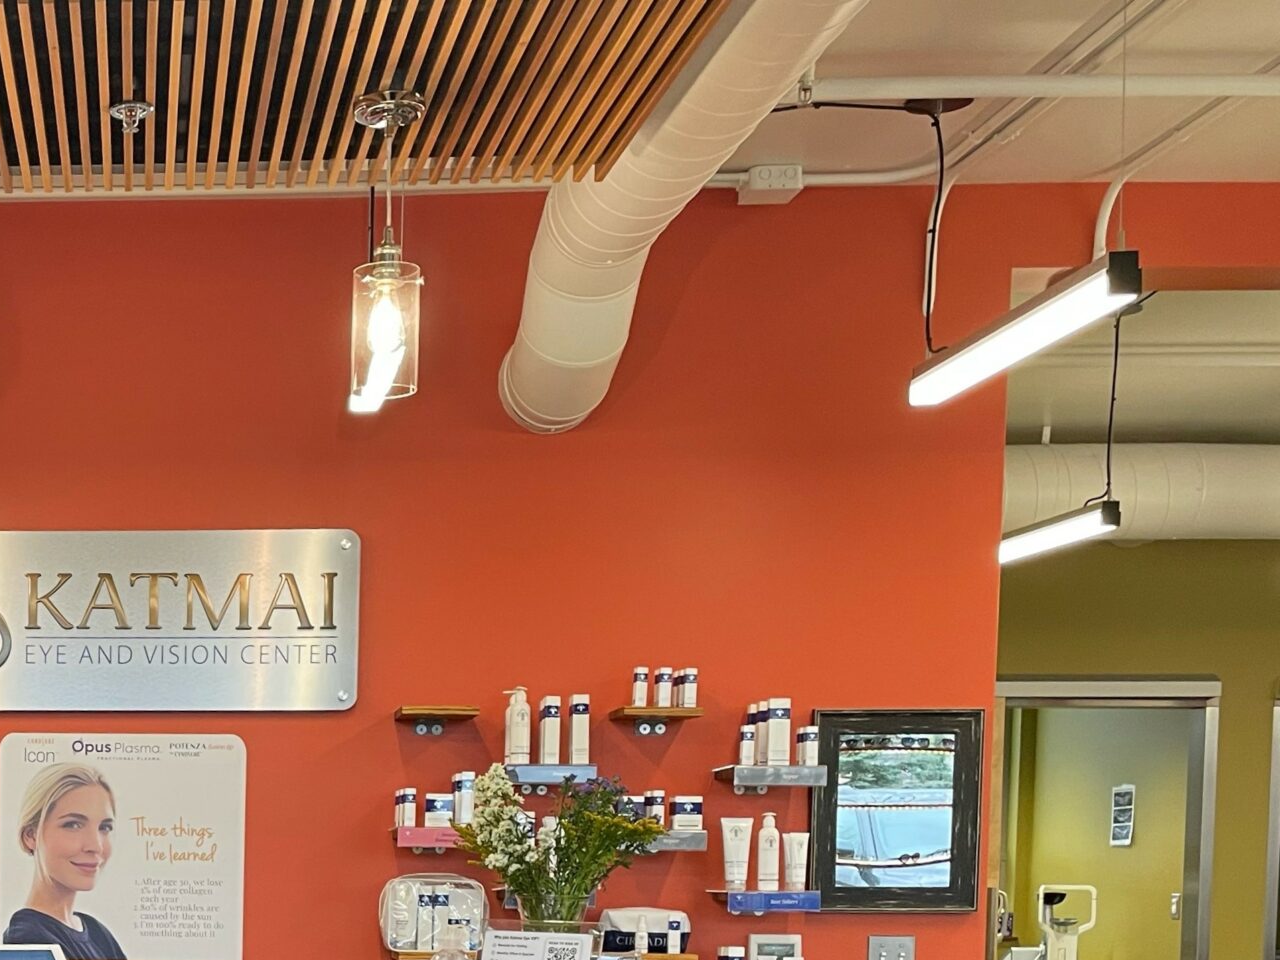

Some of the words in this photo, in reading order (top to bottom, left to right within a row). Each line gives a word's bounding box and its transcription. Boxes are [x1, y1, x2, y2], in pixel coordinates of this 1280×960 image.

[24, 572, 337, 631] KATMAI
[25, 644, 67, 665] EYE
[78, 644, 133, 665] AND
[144, 644, 229, 665] VISION
[240, 644, 337, 665] CENTER
[24, 747, 55, 763] Icon
[72, 740, 112, 755] Opus
[114, 742, 160, 754] Plasma
[129, 816, 168, 836] Three
[171, 816, 215, 847] things
[145, 841, 167, 861] I've
[169, 843, 217, 864] learned
[142, 878, 160, 886] After
[179, 886, 213, 896] collagen
[158, 903, 167, 911] of
[169, 904, 204, 912] wrinkles
[140, 912, 168, 920] caused
[185, 929, 207, 937] about
